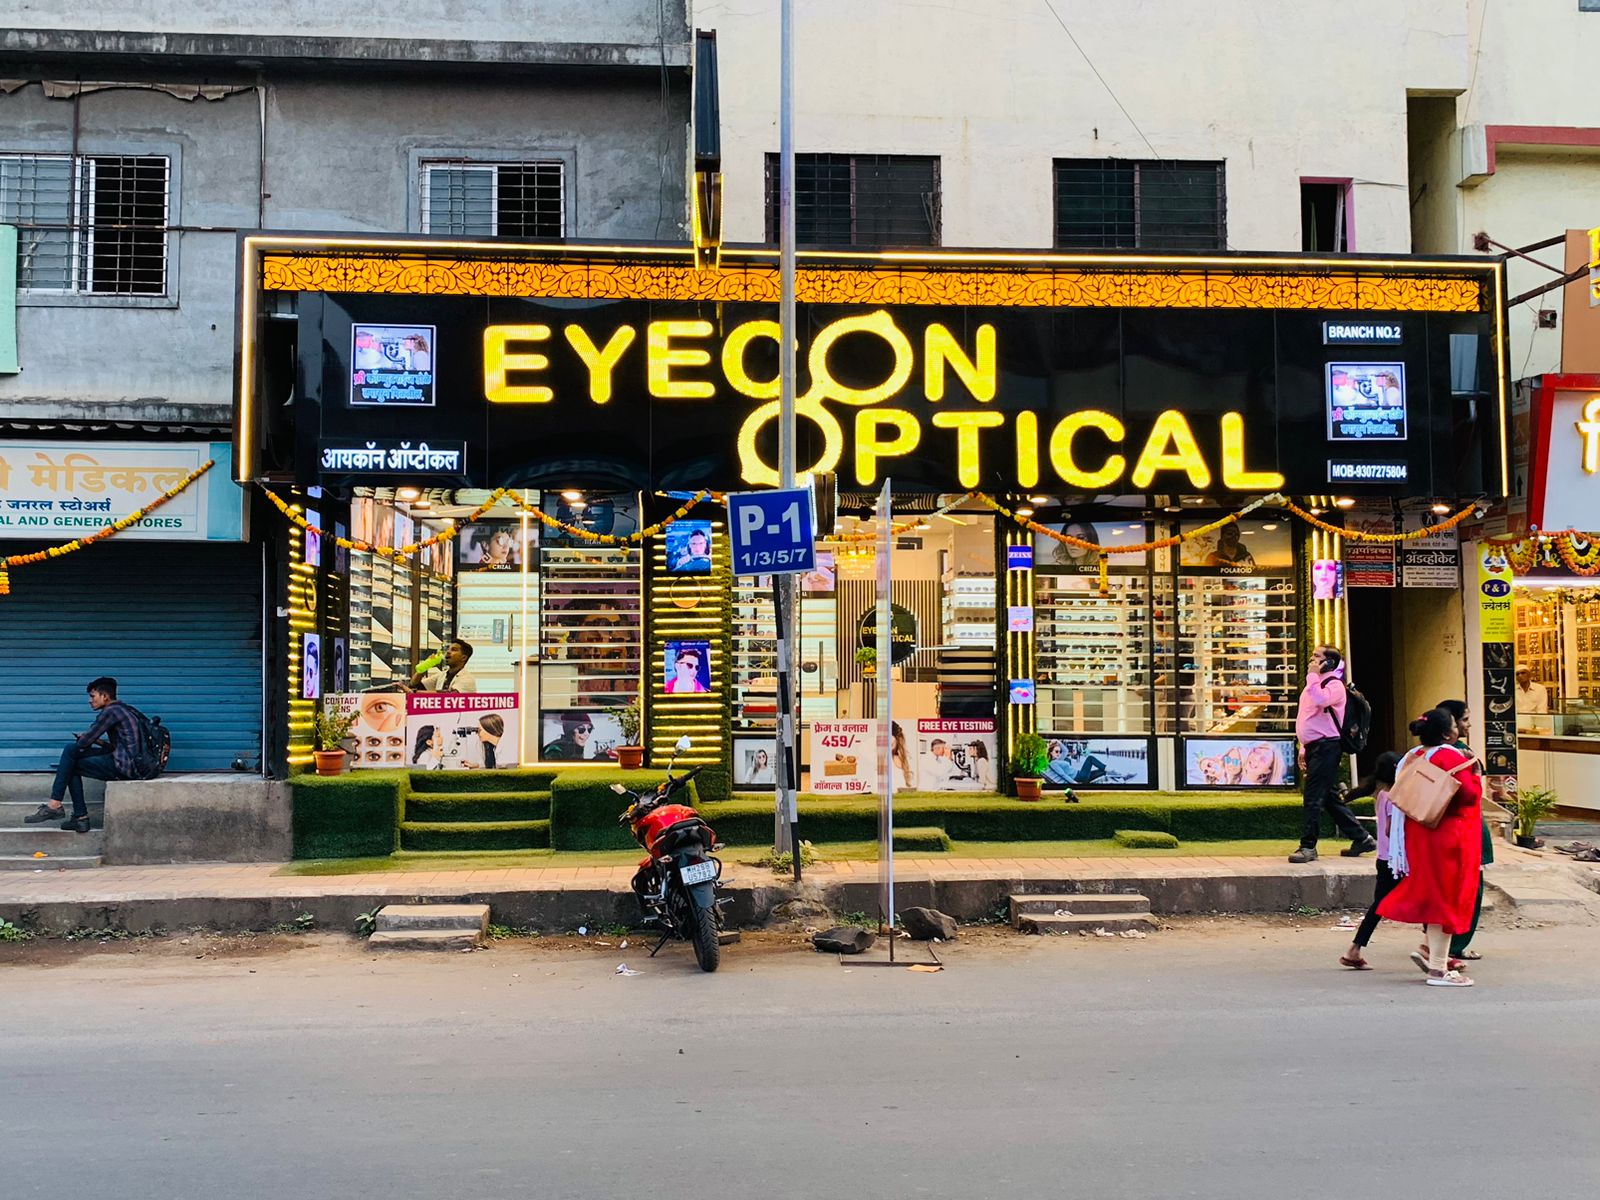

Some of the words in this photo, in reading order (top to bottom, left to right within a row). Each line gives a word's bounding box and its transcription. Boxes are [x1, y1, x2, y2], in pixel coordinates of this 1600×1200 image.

[1328, 325, 1374, 339] BRANCH
[1375, 325, 1401, 339] NO.2
[483, 309, 997, 404] EYECON
[737, 398, 1285, 490] OPTICAL
[321, 441, 386, 470] आयकॉन
[387, 441, 459, 470] ऑप्टीकल
[27, 452, 190, 493] मेडिकल
[1332, 464, 1407, 478] MOB-9307275804
[6, 499, 53, 511] जनरल
[59, 497, 111, 512] स्टोअर्स
[18, 516, 49, 526] AND
[738, 501, 801, 546] P-1
[741, 548, 807, 567] 1/3/5/7
[325, 696, 358, 705] CONTACT
[412, 697, 442, 709] FREE
[444, 697, 466, 709] EYE
[467, 696, 515, 709] TESTING
[814, 722, 832, 734] फ्रेम
[834, 724, 840, 733] व
[842, 723, 868, 733] ग्लास
[919, 721, 940, 731] FREE
[941, 721, 957, 731] EYE
[958, 721, 994, 731] TESTING
[821, 735, 861, 749] 459/-
[845, 781, 872, 791] 199/-
